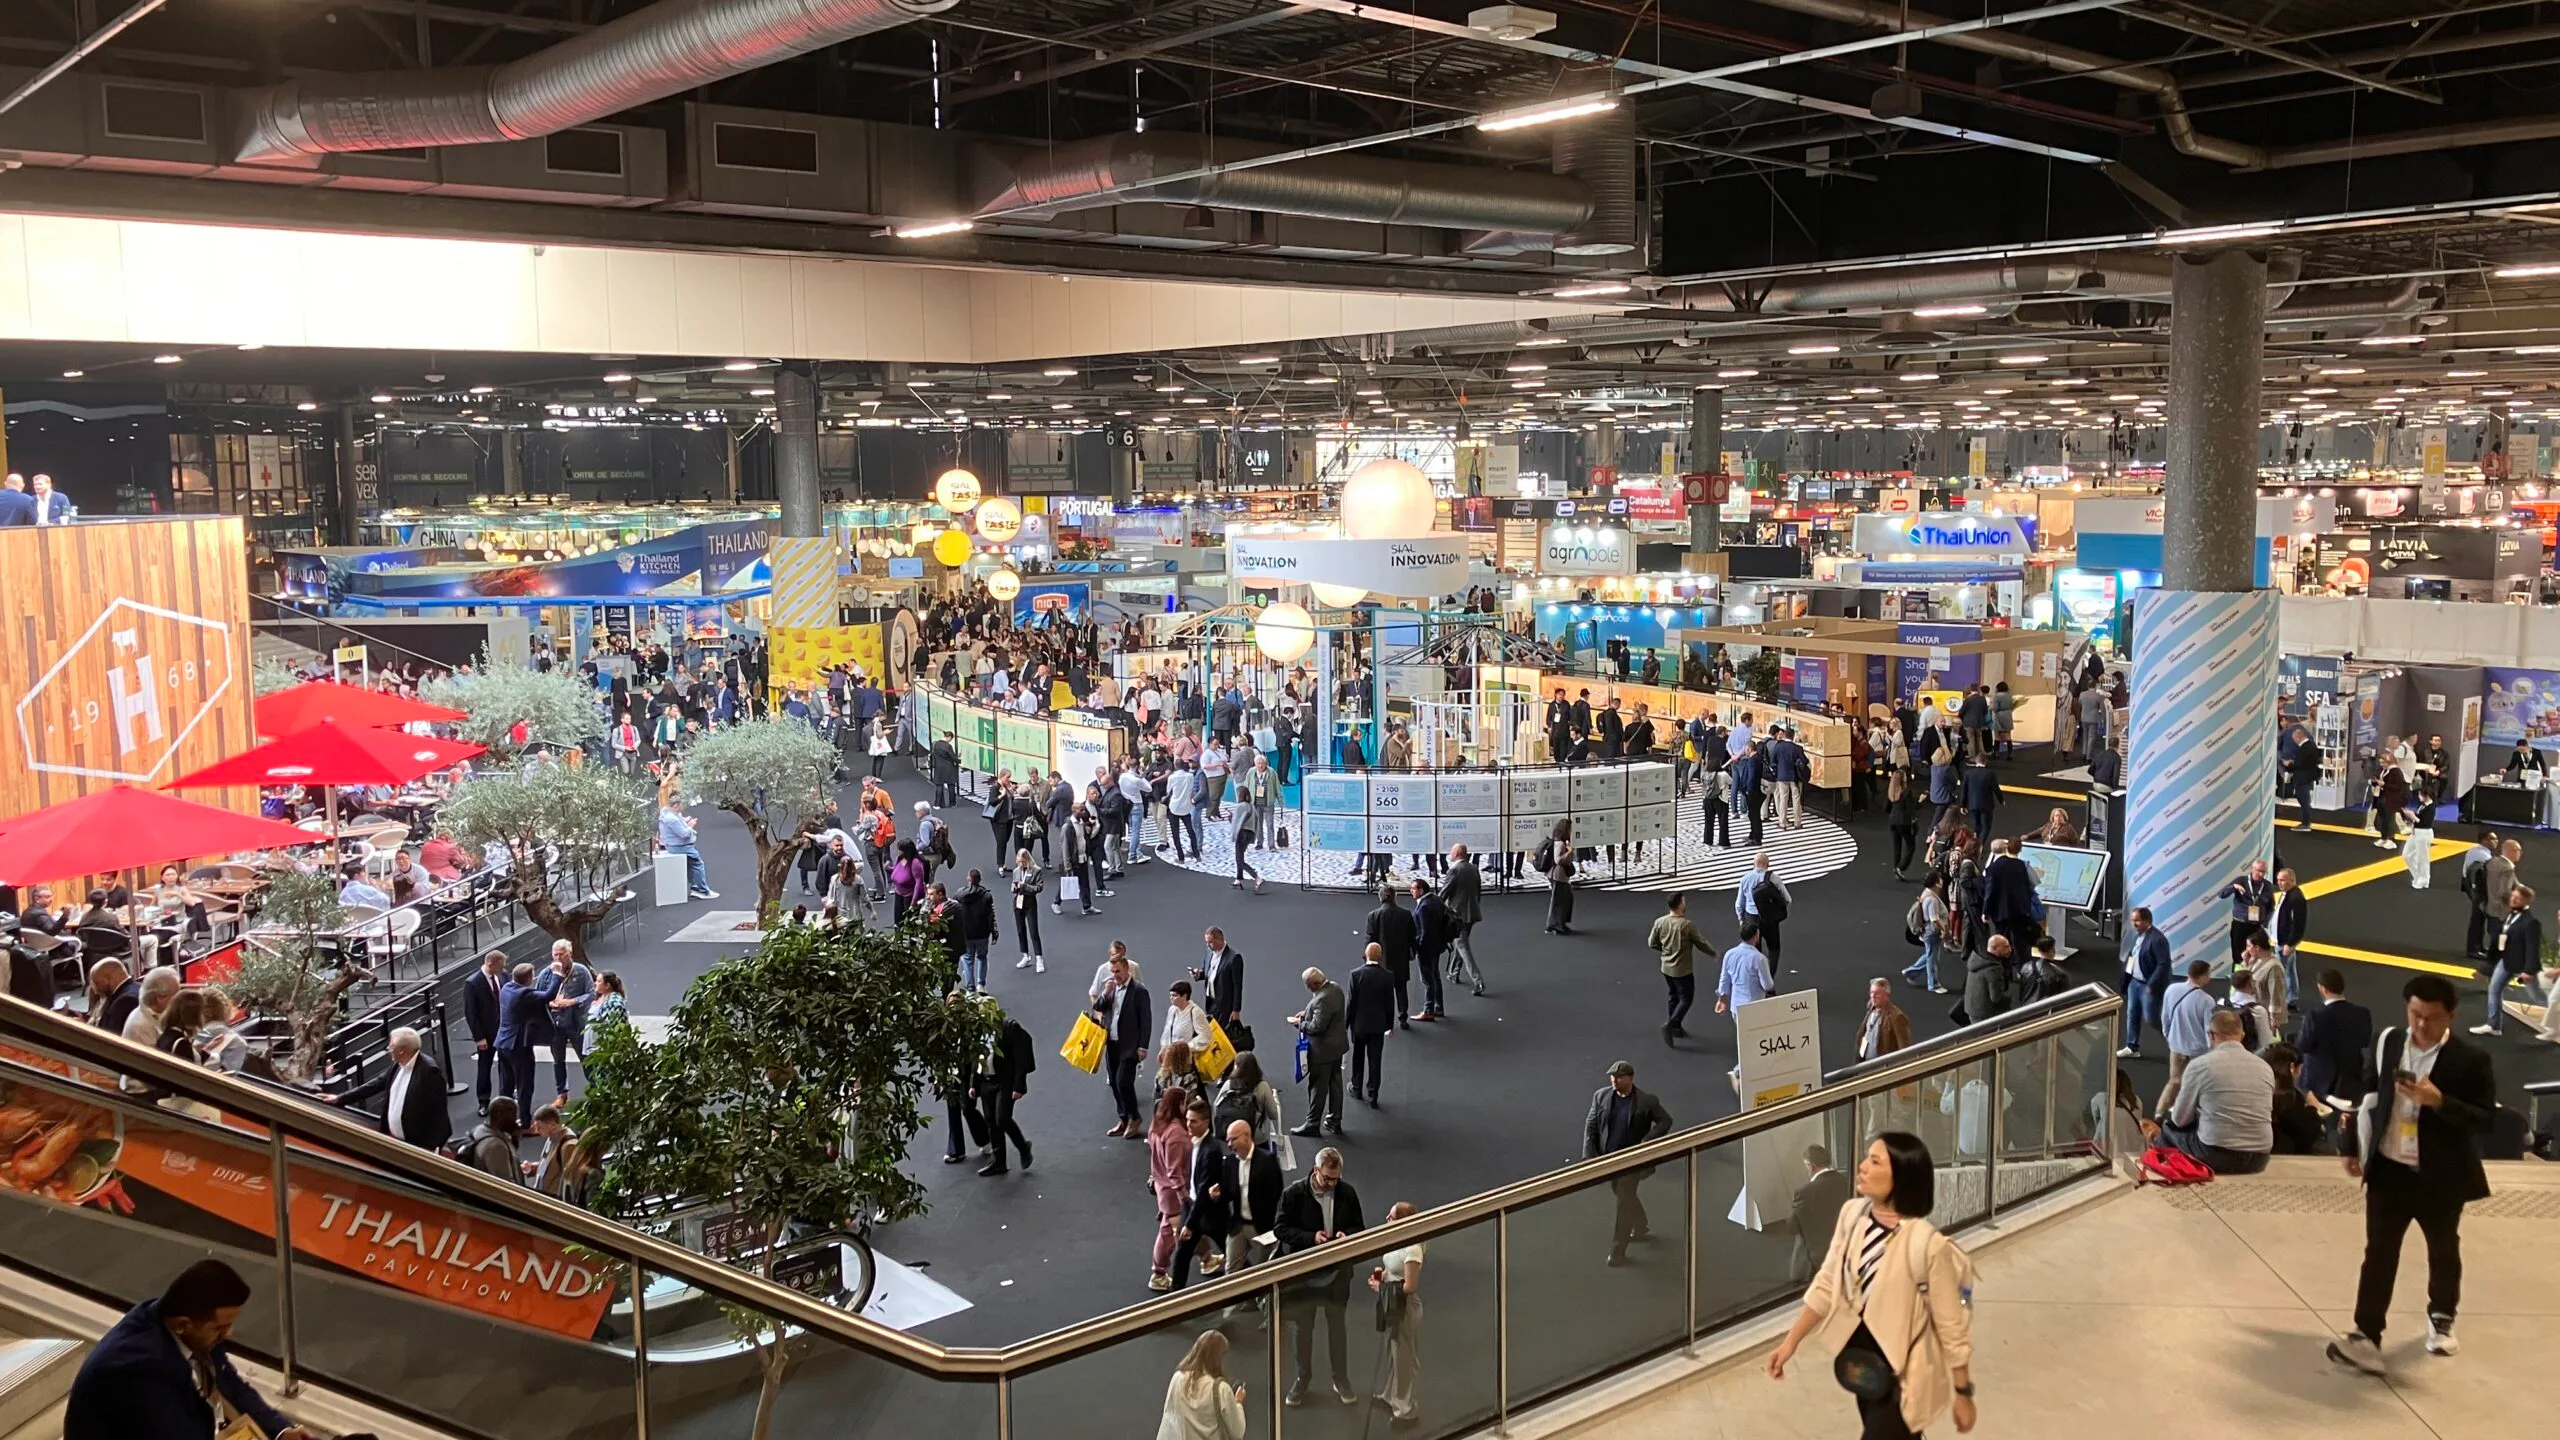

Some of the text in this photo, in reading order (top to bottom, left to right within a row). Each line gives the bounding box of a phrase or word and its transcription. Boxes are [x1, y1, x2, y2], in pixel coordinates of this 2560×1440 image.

[1106, 430, 1114, 446] 6
[1123, 430, 1134, 446] 6
[2430, 454, 2439, 470] F
[434, 472, 468, 480] SECOURS
[951, 491, 980, 500] TASTE
[1628, 496, 1671, 507] Catalunya
[1059, 500, 1116, 517] PORTUGAL
[985, 520, 1020, 530] TASTE
[420, 528, 457, 547] CHINA
[708, 530, 768, 556] THAILAND
[1391, 543, 1416, 554] SIAL
[2380, 540, 2429, 551] LATVIA
[639, 553, 680, 563] Thailand
[1236, 555, 1297, 569] INNOVATION
[1391, 553, 1461, 568] INNOVATION
[287, 566, 327, 585] THAILAND
[1905, 635, 1940, 644] KANTAR
[168, 660, 195, 688] 68
[1846, 682, 1858, 697] R
[106, 654, 164, 756] H
[1060, 738, 1108, 753] INNOVATION
[1376, 797, 1398, 807] 560
[1376, 835, 1399, 845] 560
[1790, 1001, 1810, 1012] SIAL
[1759, 1034, 1796, 1056] SIAL
[212, 1166, 245, 1182] DITP
[319, 1193, 594, 1298] THAILAND
[363, 1252, 513, 1303] PAVILION
